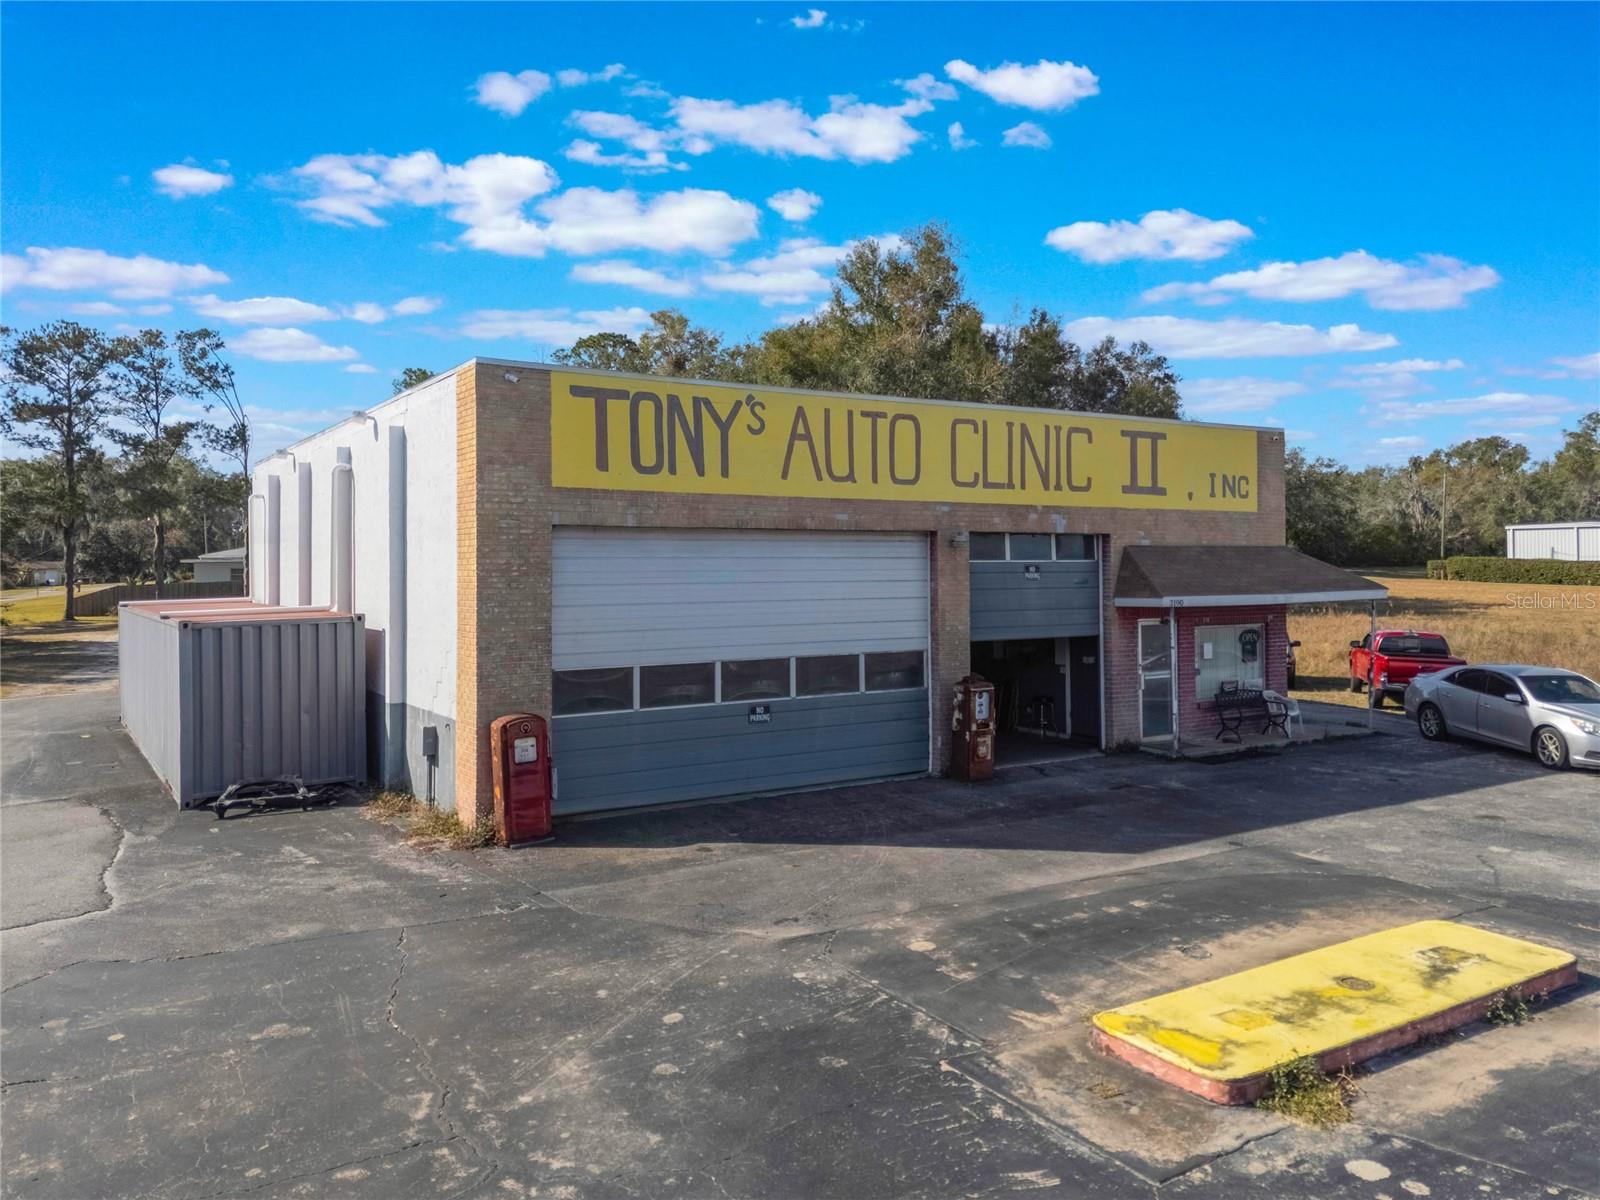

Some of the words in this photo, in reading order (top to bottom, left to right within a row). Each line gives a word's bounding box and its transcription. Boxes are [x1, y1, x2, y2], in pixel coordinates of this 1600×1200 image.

[781, 405, 922, 486] AUTO
[950, 418, 1093, 492] CLINIC
[1209, 472, 1249, 499] INC
[1241, 632, 1258, 642] OPEN
[756, 706, 765, 714] NO
